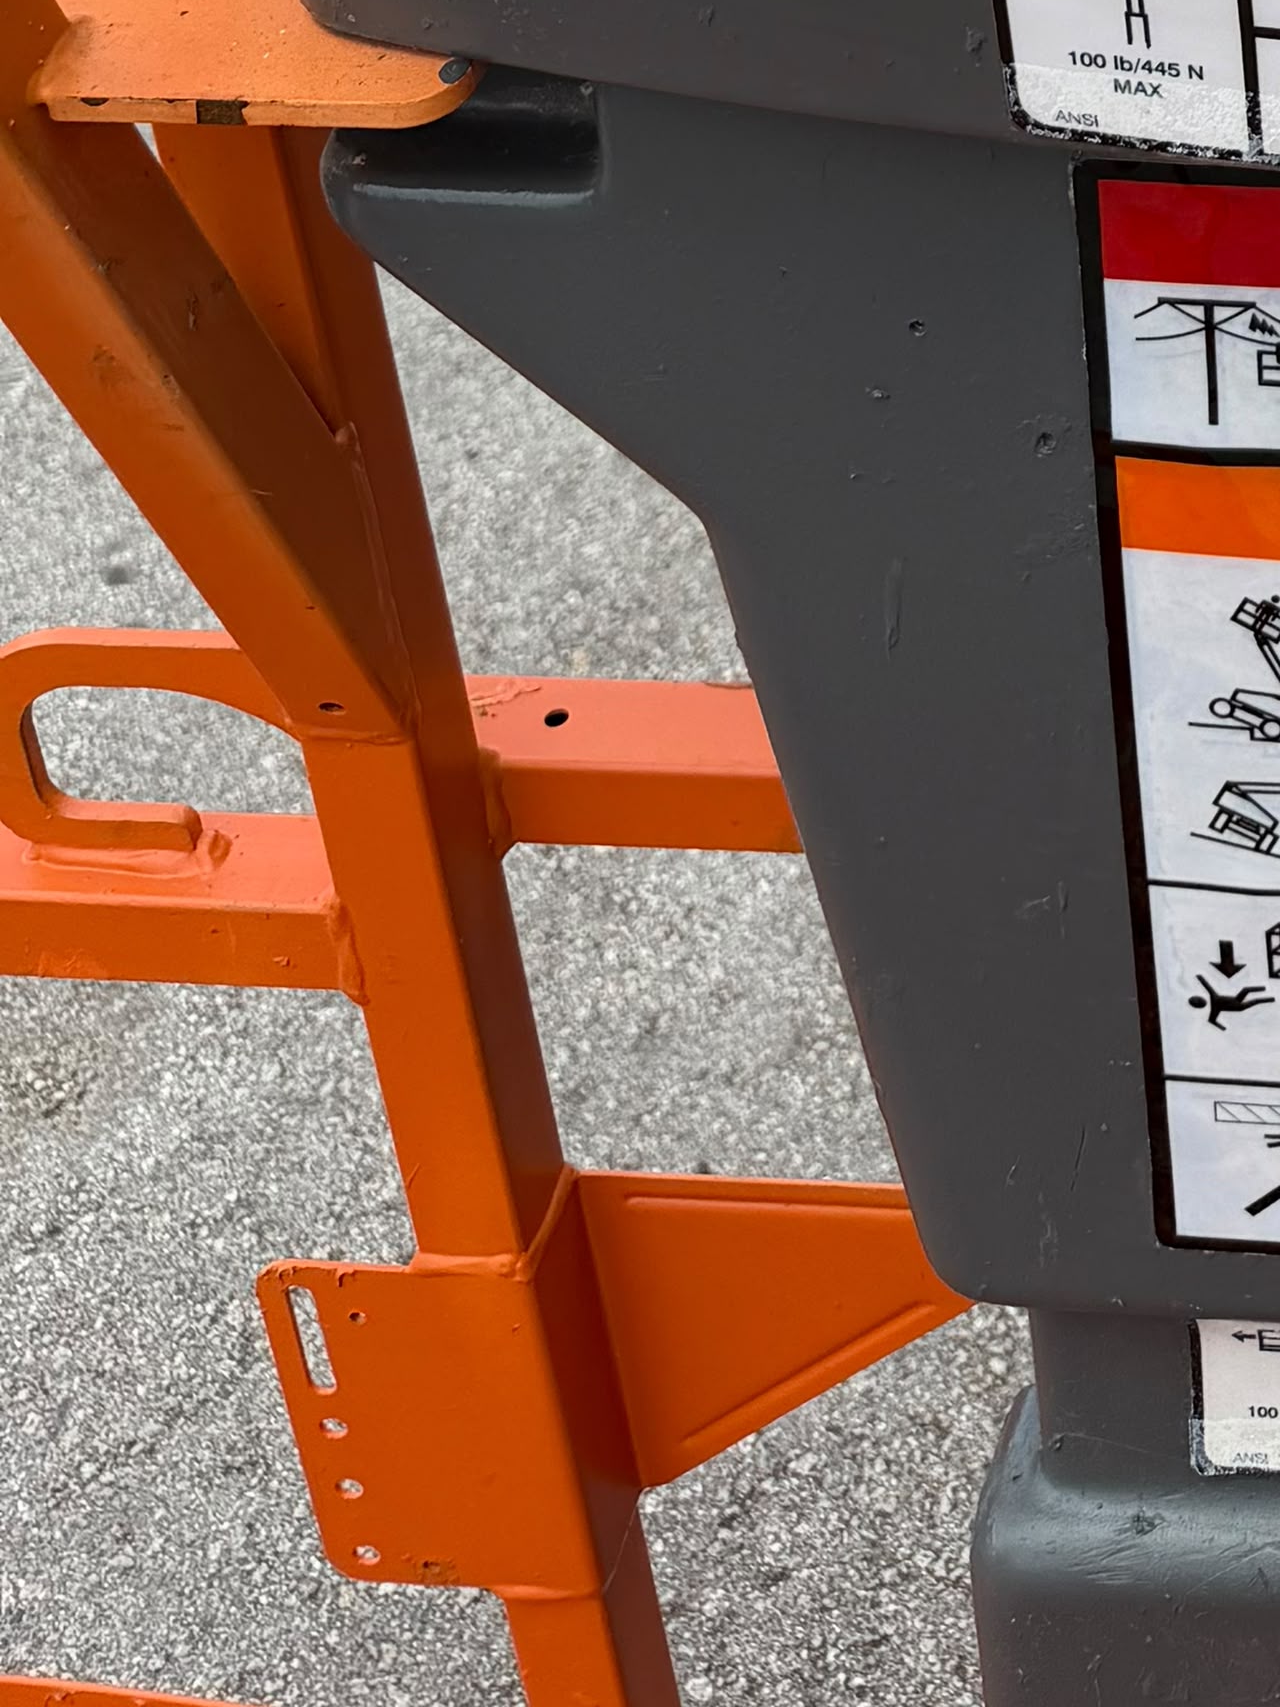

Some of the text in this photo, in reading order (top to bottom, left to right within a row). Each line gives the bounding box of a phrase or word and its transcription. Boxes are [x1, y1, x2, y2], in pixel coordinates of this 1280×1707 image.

[1069, 52, 1203, 80] 100 lb/445 N
[1114, 79, 1162, 98] MAX
